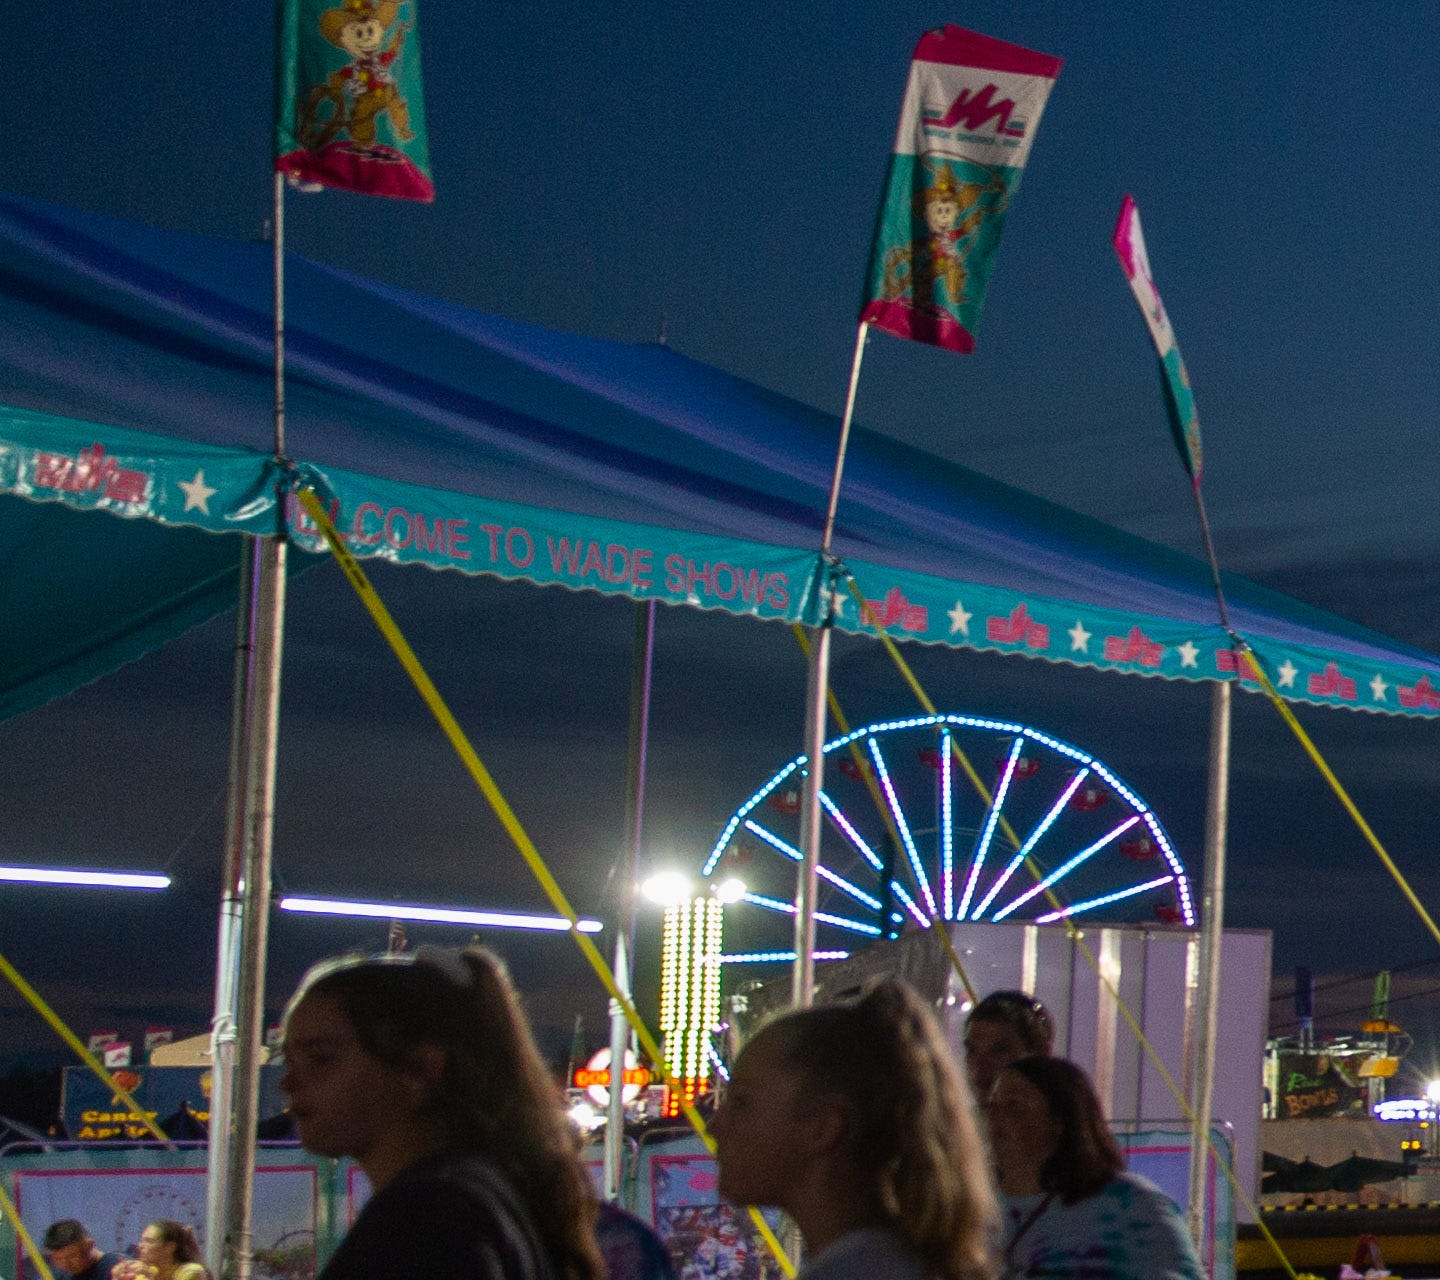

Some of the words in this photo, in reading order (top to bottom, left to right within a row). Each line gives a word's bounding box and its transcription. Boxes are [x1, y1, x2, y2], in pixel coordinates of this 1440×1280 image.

[481, 523, 535, 568] TO
[547, 535, 654, 588] WADE
[665, 553, 790, 610] SHOWS
